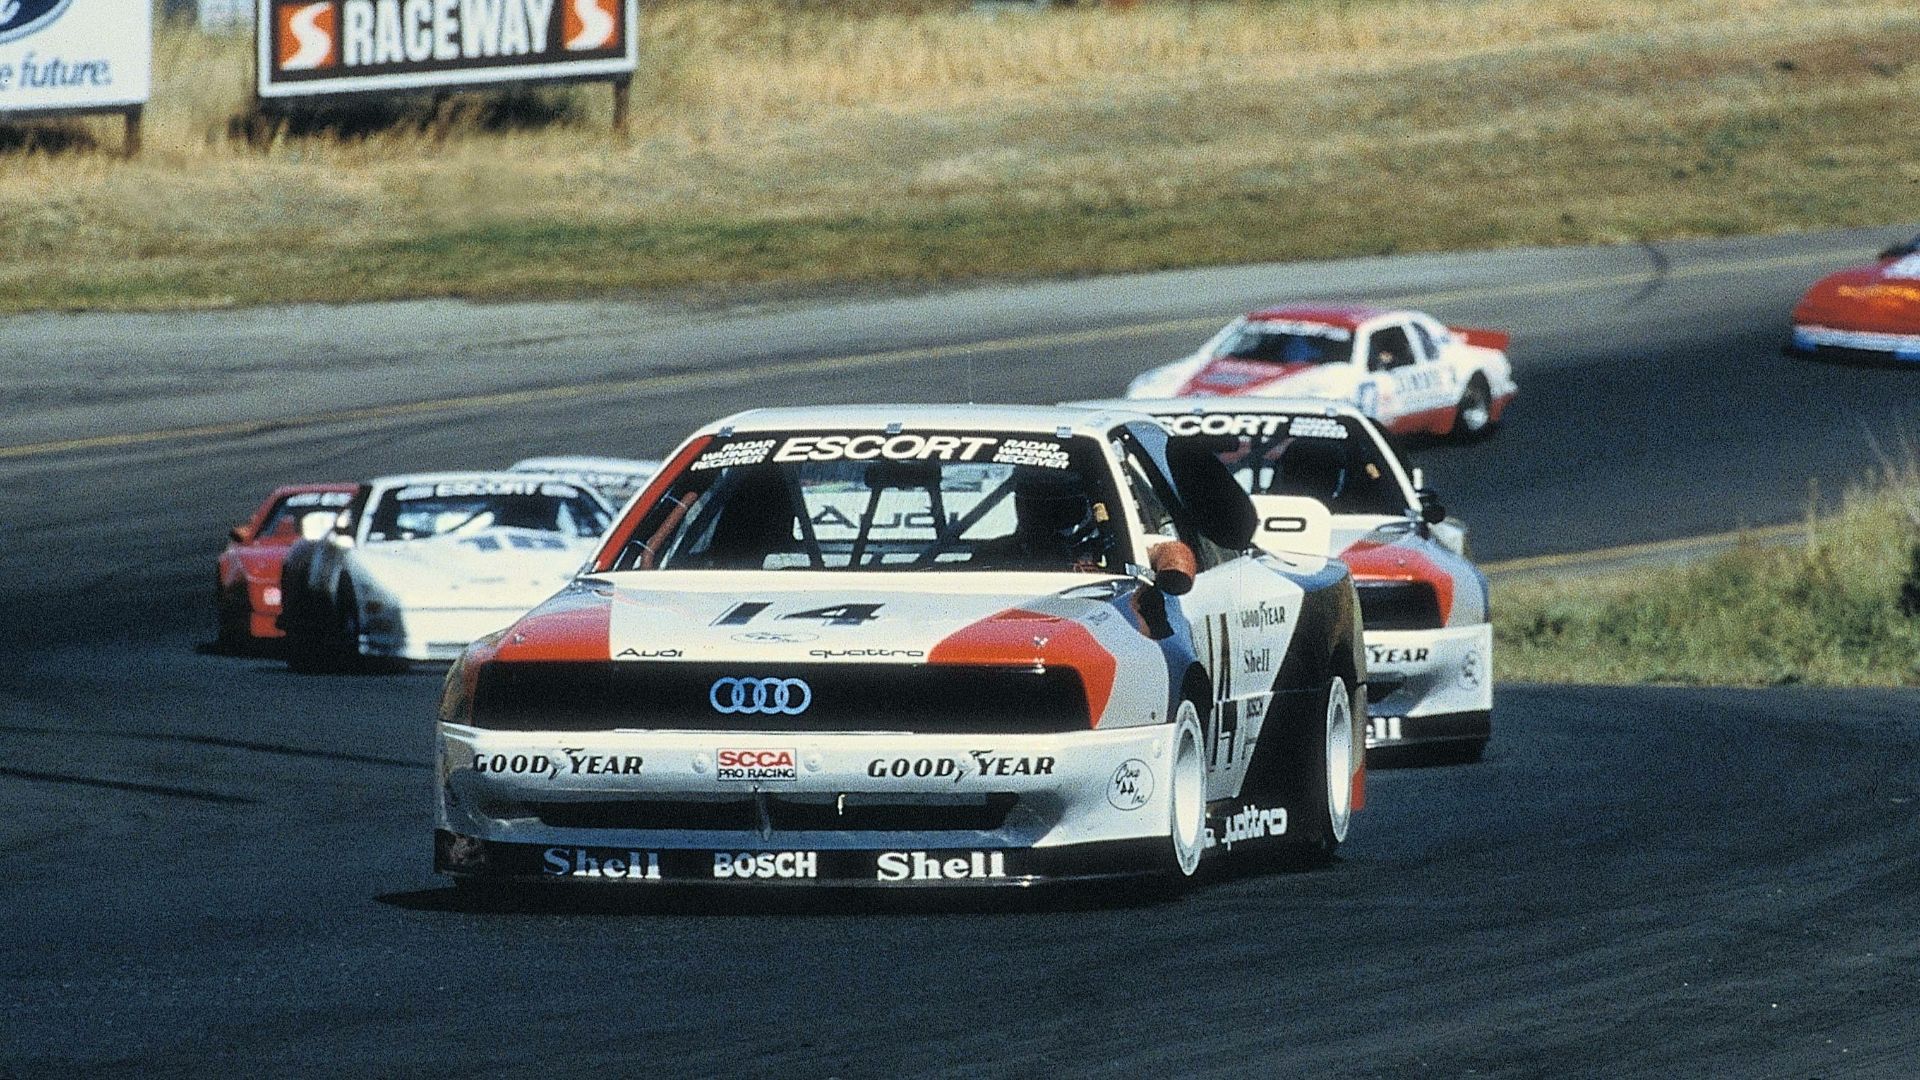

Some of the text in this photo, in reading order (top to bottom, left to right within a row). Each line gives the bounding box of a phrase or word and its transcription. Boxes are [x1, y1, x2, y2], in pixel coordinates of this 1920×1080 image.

[341, 0, 552, 67] RACEWAY
[1157, 414, 1290, 436] SCORT
[722, 439, 776, 452] RADAR
[772, 435, 998, 462] ESCORT
[1003, 439, 1060, 452] RADAR
[701, 448, 770, 462] WARNING
[992, 453, 1070, 469] RECEIVER
[998, 447, 1069, 461] WARNING
[690, 455, 766, 471] RECEIVER
[708, 602, 886, 627] 14
[809, 649, 924, 659] quattro
[1244, 648, 1270, 673] Shell
[719, 751, 793, 767] SCCA
[719, 768, 795, 778] PRO RACING
[543, 847, 662, 879] Shell
[713, 851, 817, 878] BOSCH
[877, 852, 1006, 881] Shell
